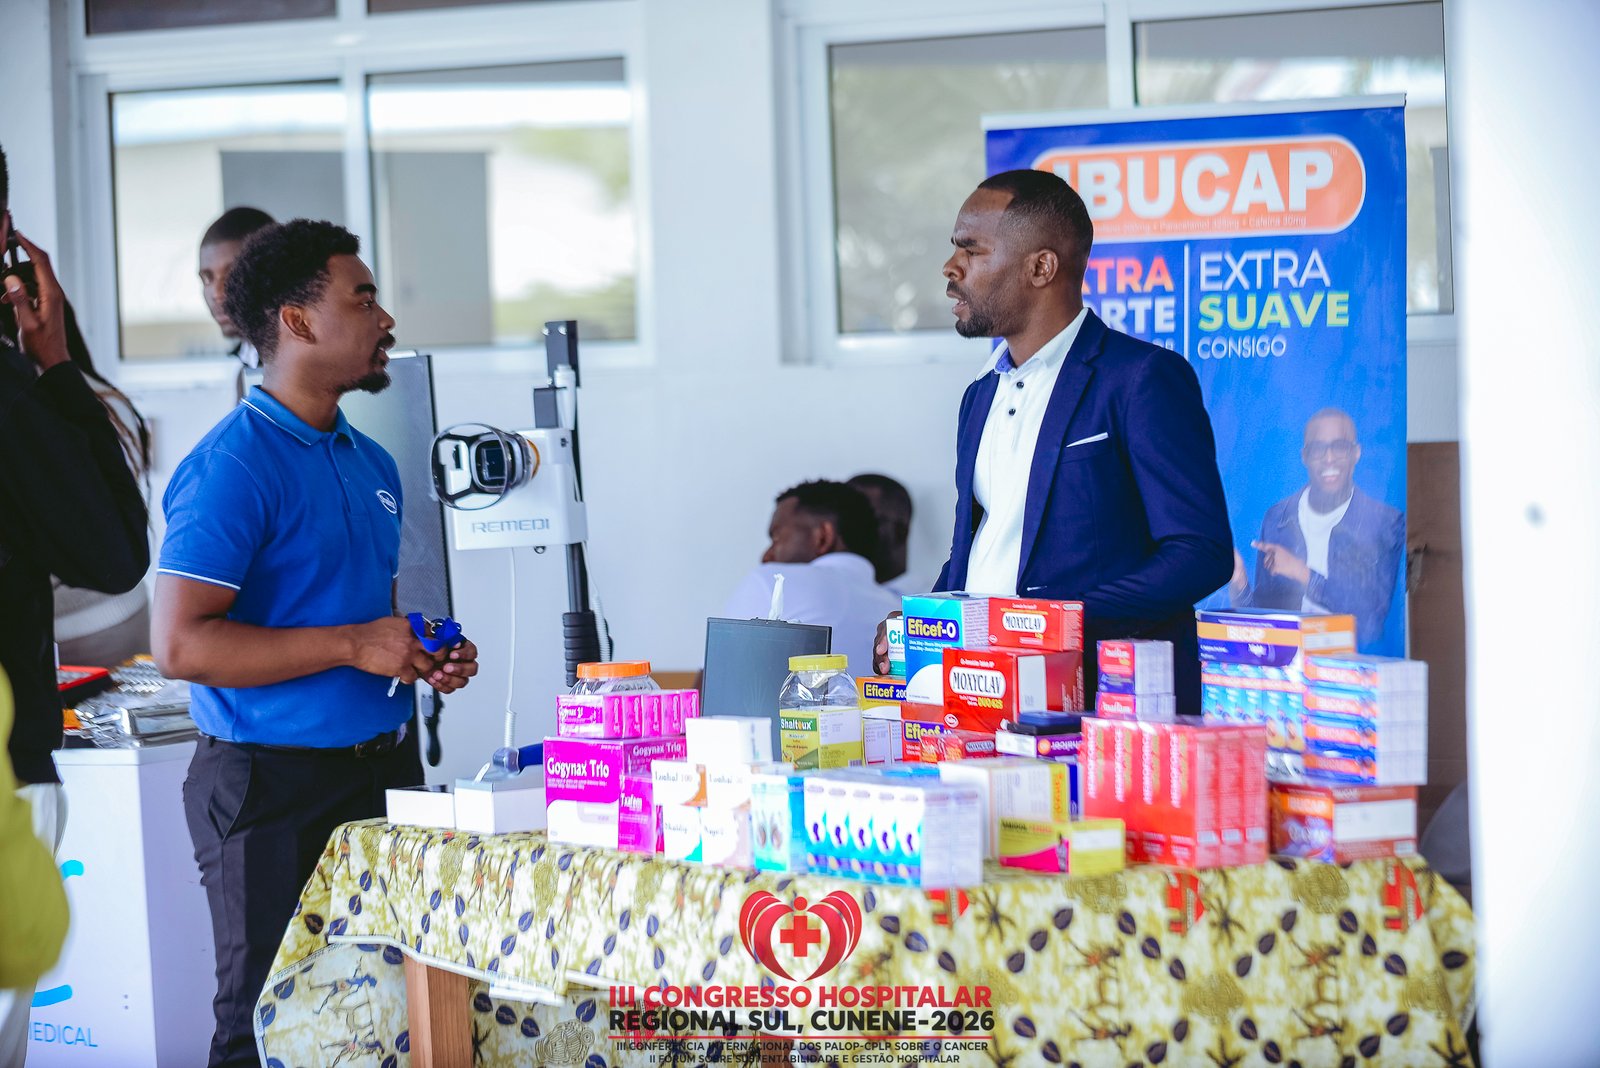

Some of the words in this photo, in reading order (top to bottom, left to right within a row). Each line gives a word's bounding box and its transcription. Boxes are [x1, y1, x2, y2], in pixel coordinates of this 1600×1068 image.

[1053, 149, 1334, 220] BUCAP
[1082, 256, 1174, 295] TRA
[1200, 248, 1331, 291] EXTRA
[1083, 297, 1175, 334] RTE
[1198, 291, 1349, 331] SUAVE
[1197, 334, 1287, 359] CONSIGO
[472, 518, 549, 533] REMEDI
[907, 618, 956, 638] Eficef-O
[865, 684, 894, 697] Eficef
[953, 671, 1001, 694] MOXYCLAV
[547, 757, 587, 778] Gogynax
[589, 759, 610, 778] Trio
[29, 1021, 98, 1047] EDICAL
